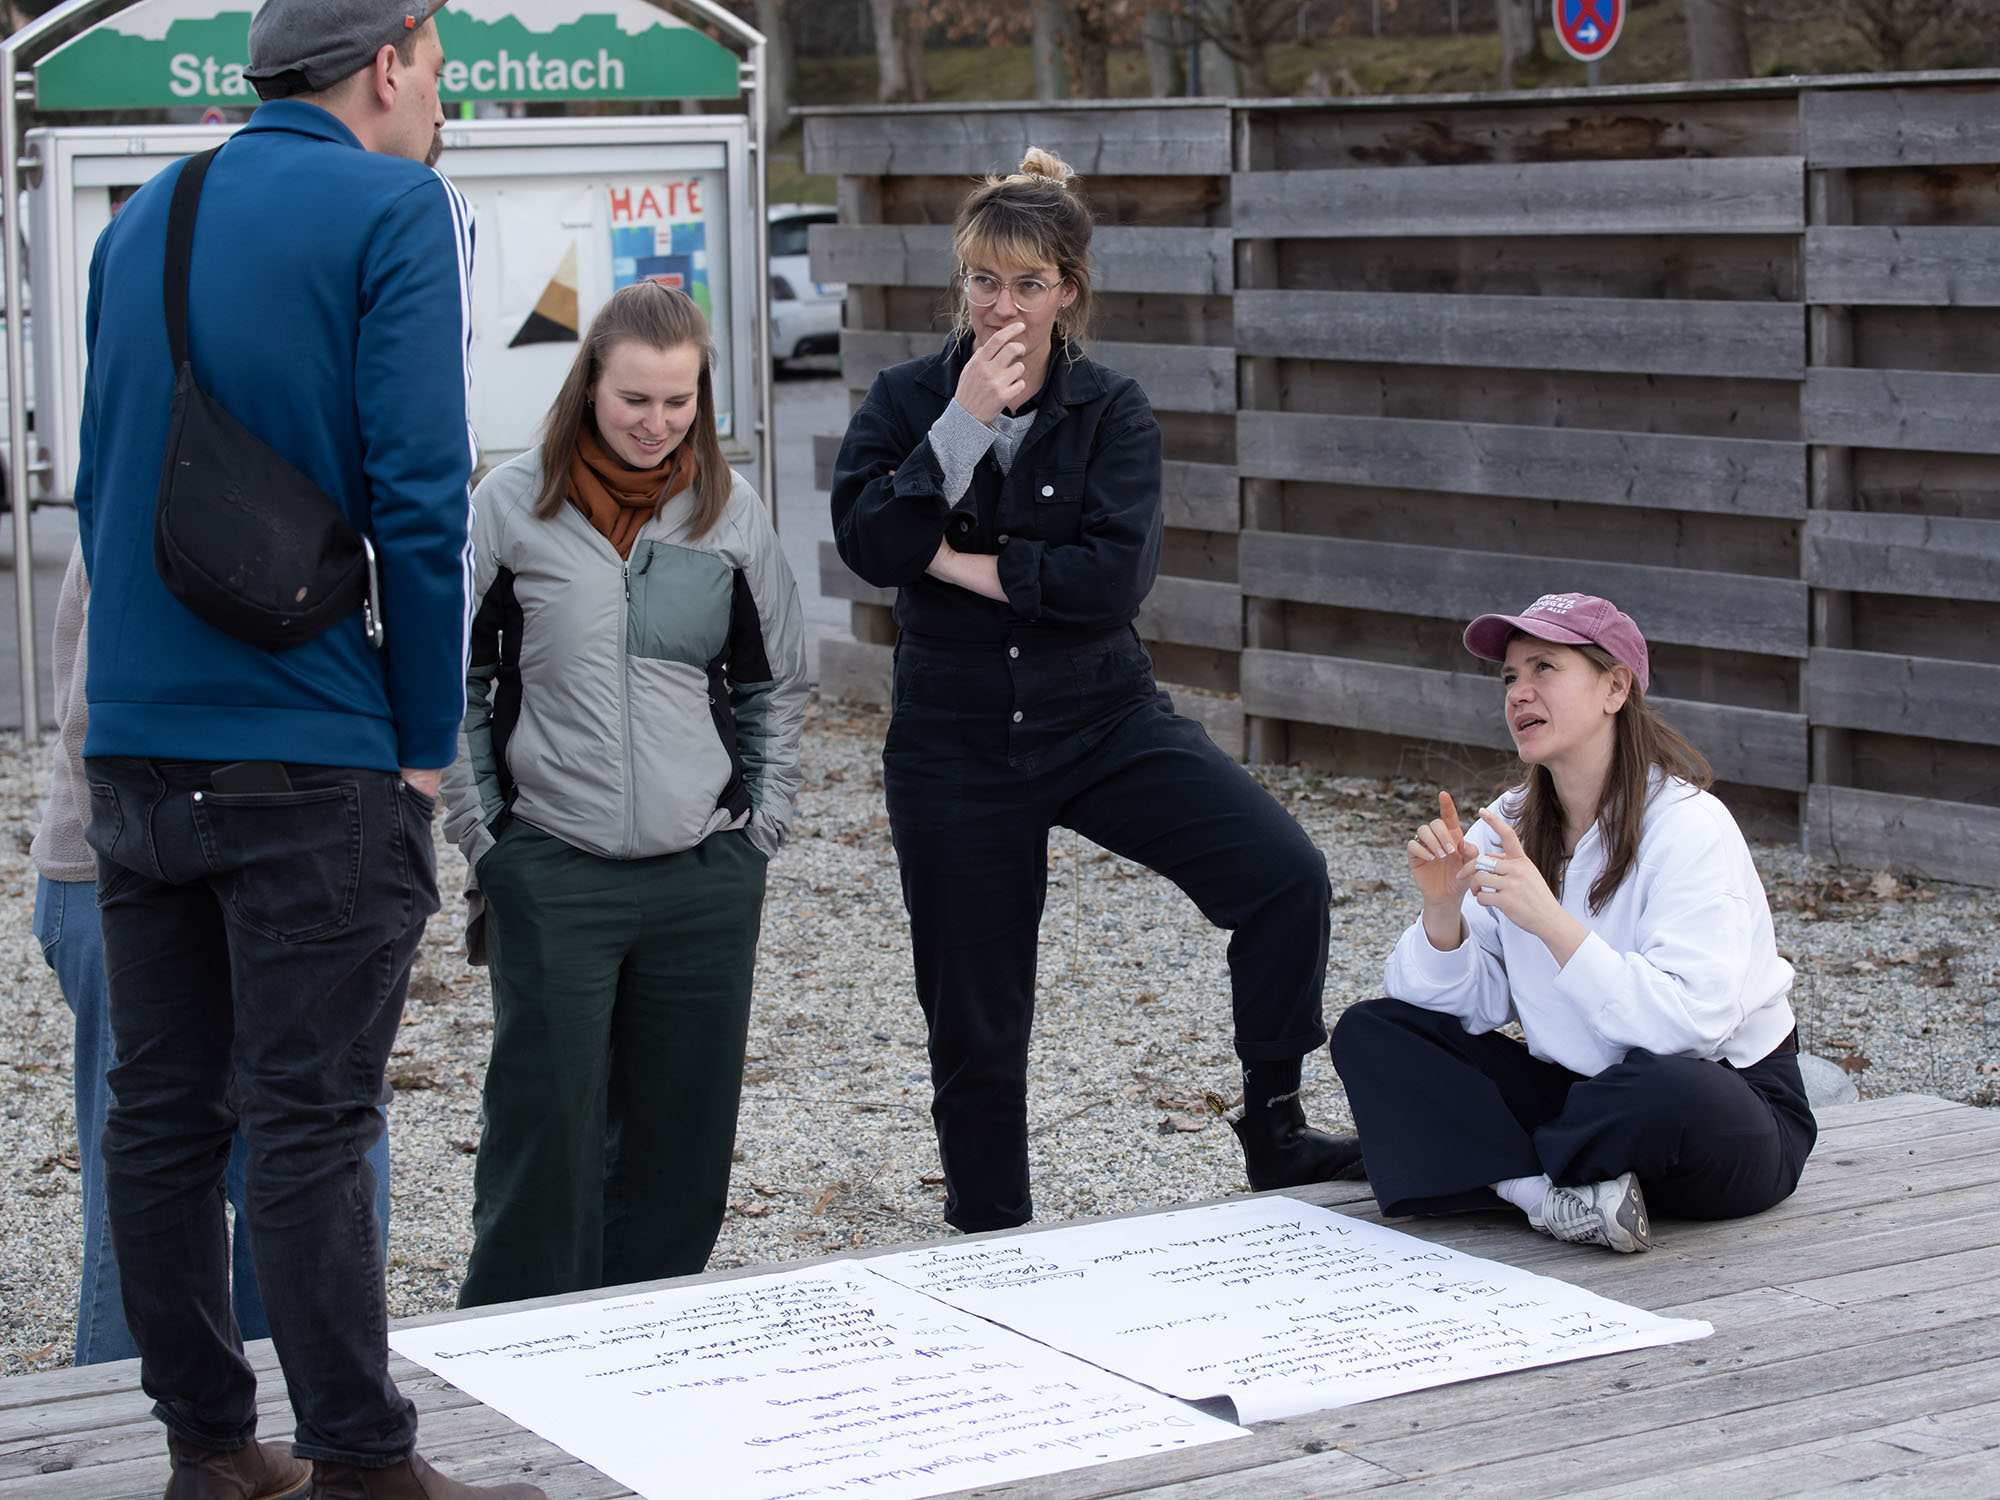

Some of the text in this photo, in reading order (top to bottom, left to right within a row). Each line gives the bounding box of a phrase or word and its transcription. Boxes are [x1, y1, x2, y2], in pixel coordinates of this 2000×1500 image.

[169, 48, 625, 97] Sta echtach
[609, 180, 703, 221] HATE
[1547, 606, 1568, 615] ALLE
[1313, 1262, 1392, 1280] Elemente
[1395, 1270, 1442, 1281] Open
[1458, 1285, 1507, 1297] Tag
[1497, 1300, 1549, 1308] Tag
[800, 1335, 895, 1356] Elemente
[1032, 1415, 1195, 1449] Demokratie
[911, 1448, 1026, 1474] unplugged
[844, 1469, 916, 1485] Words
